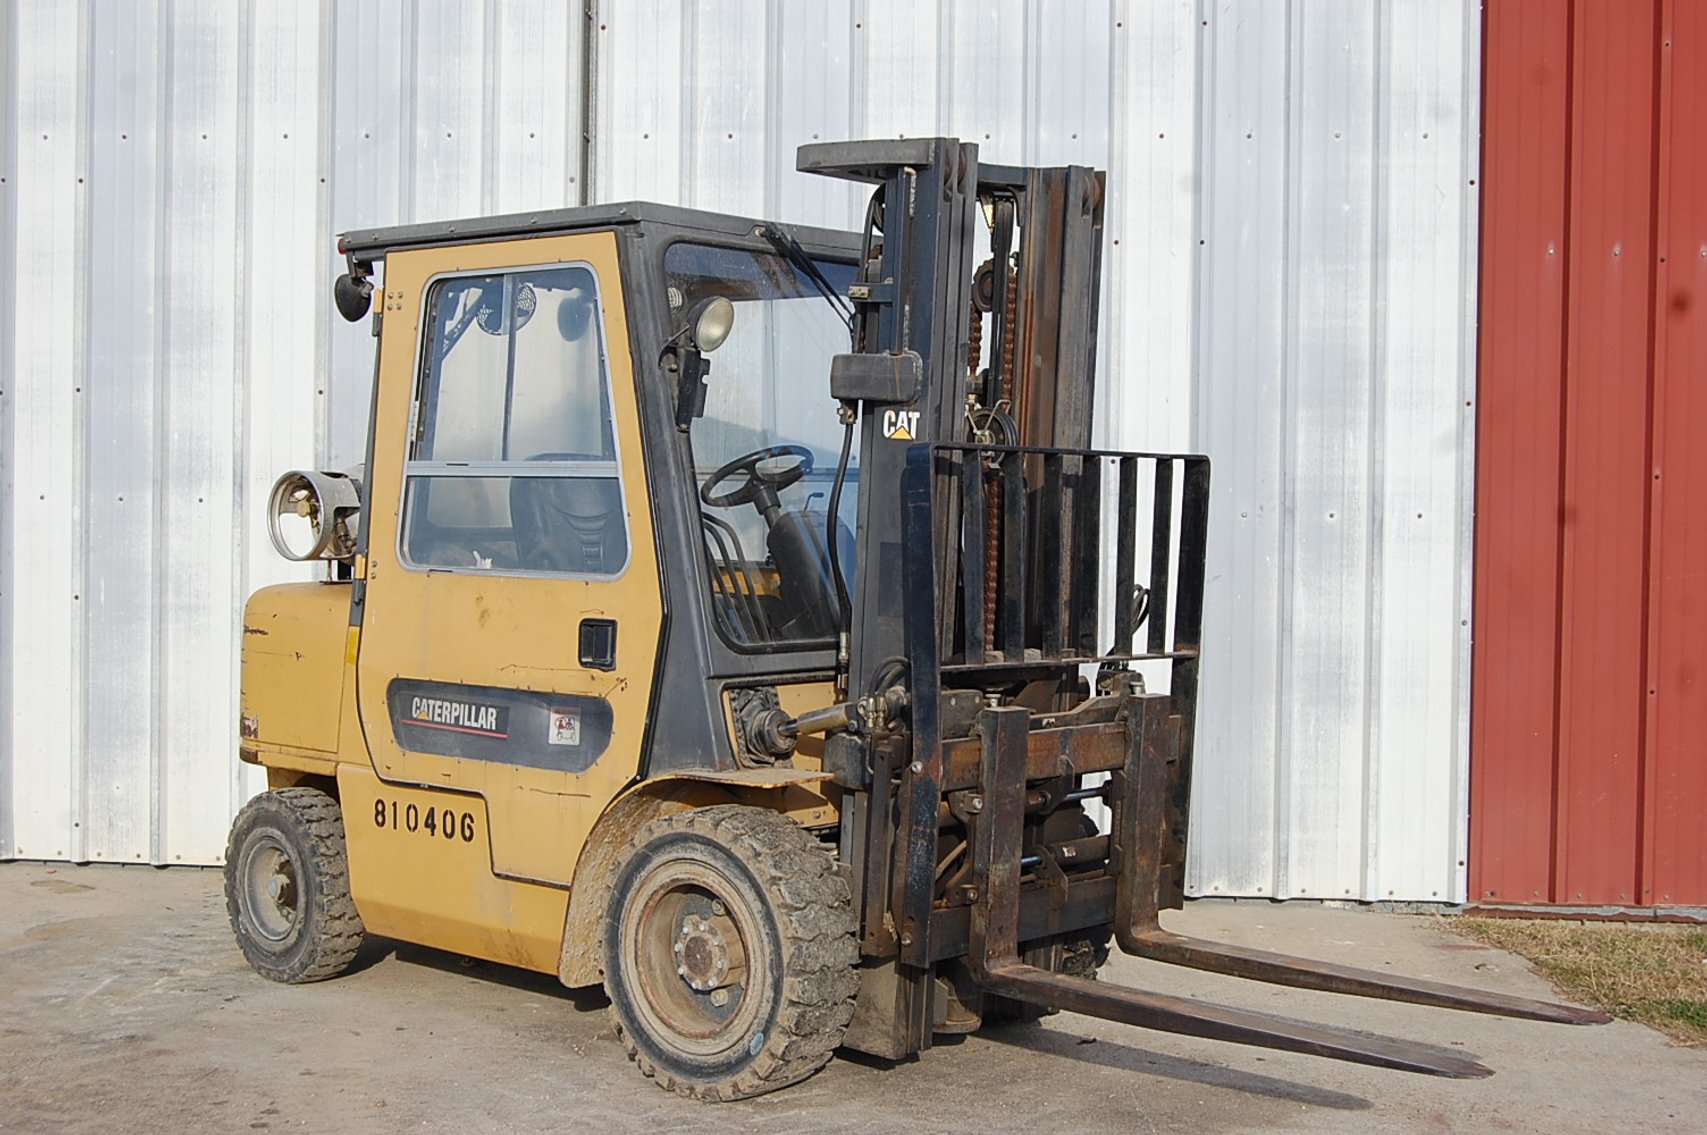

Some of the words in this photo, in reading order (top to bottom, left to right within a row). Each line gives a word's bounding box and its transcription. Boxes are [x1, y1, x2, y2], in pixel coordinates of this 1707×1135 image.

[883, 409, 920, 440] CAT
[411, 696, 497, 731] CATERPILLAR
[374, 798, 475, 842] 810406
